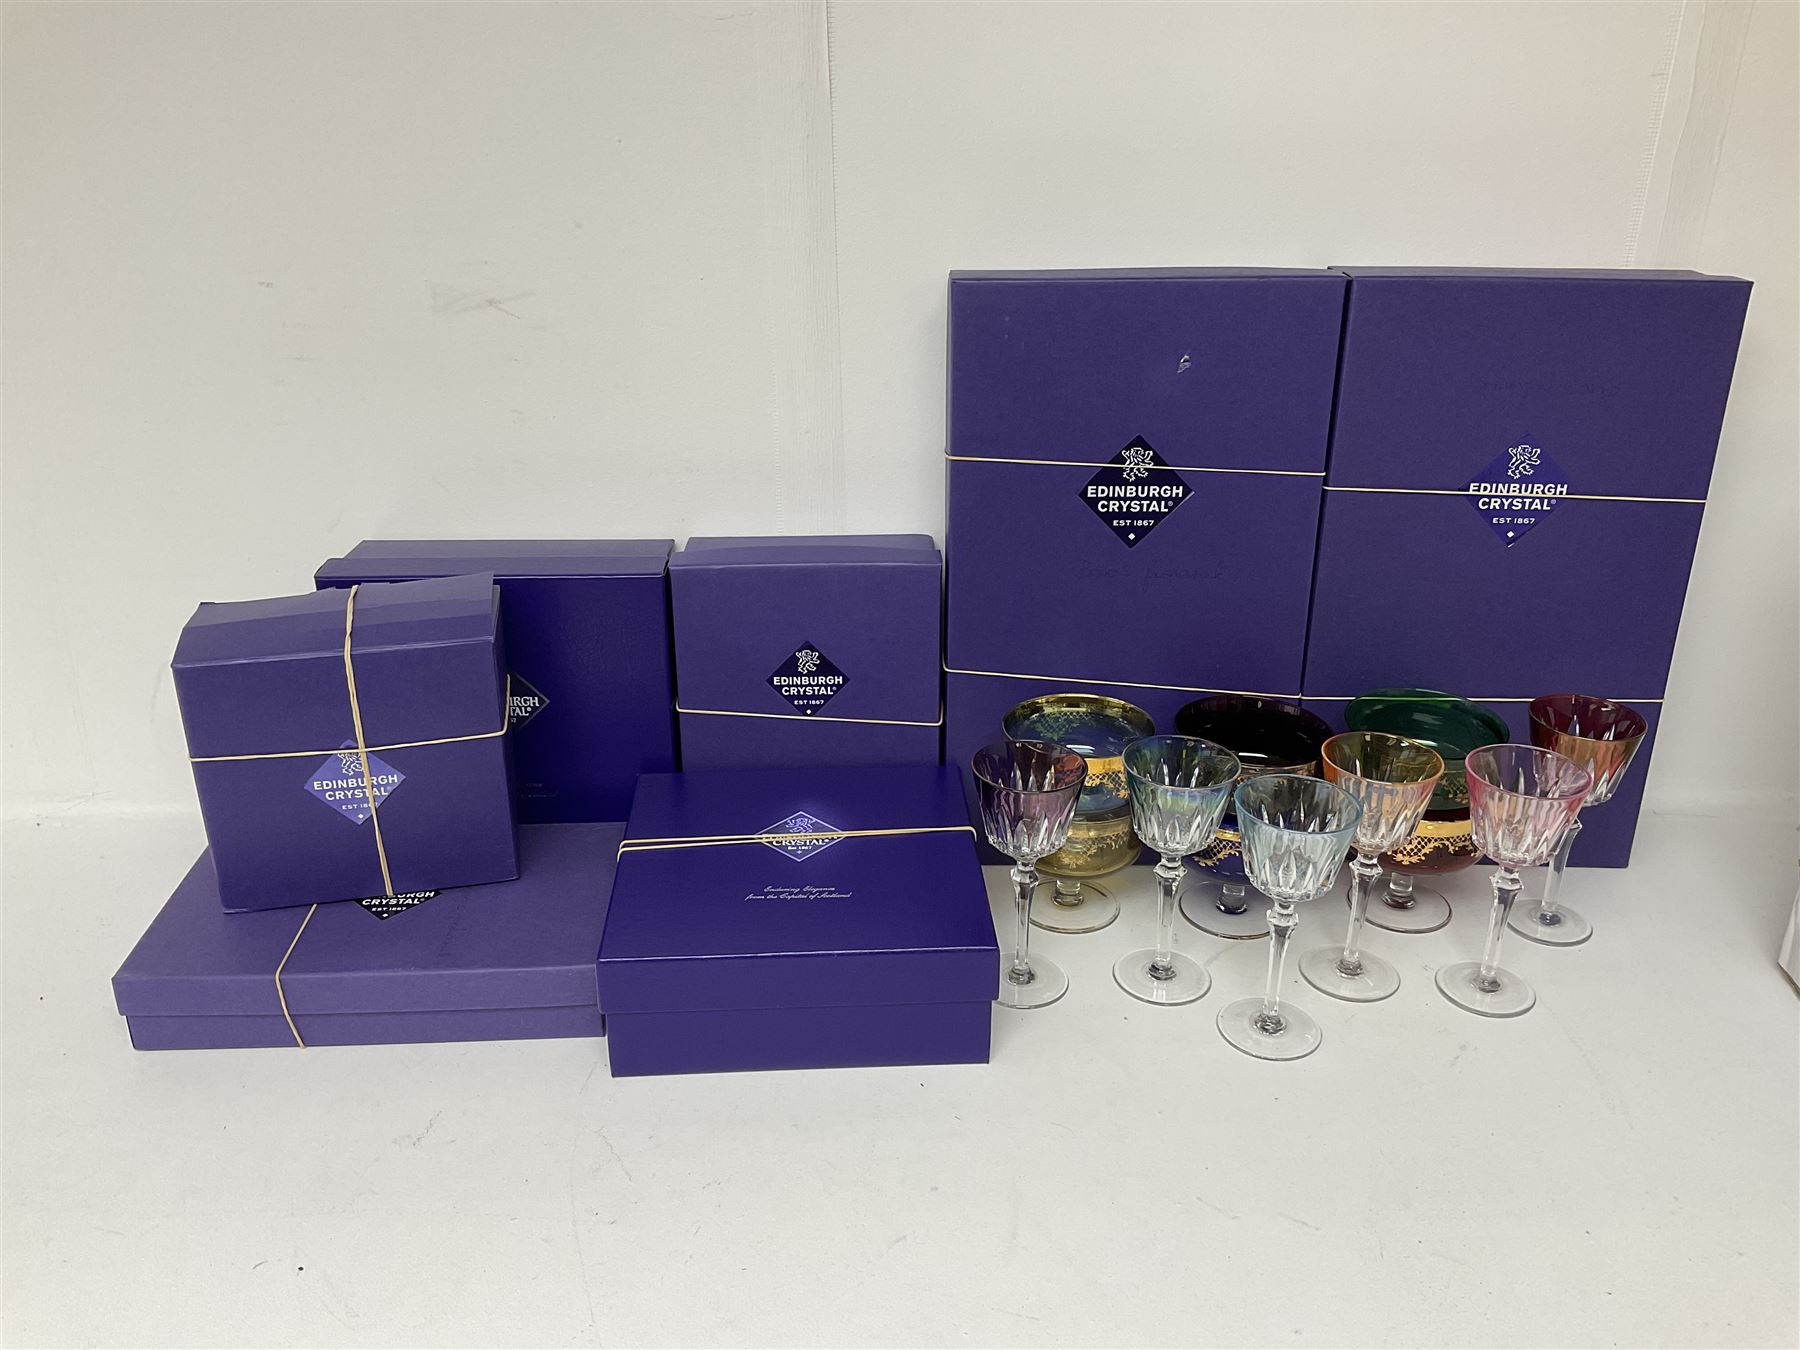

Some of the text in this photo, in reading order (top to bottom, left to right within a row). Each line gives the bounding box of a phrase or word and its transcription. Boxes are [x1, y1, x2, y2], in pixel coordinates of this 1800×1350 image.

[1086, 485, 1184, 498] EDINBURGH
[1469, 483, 1568, 496] EDINBURGH
[773, 676, 843, 685] EDINBURGH
